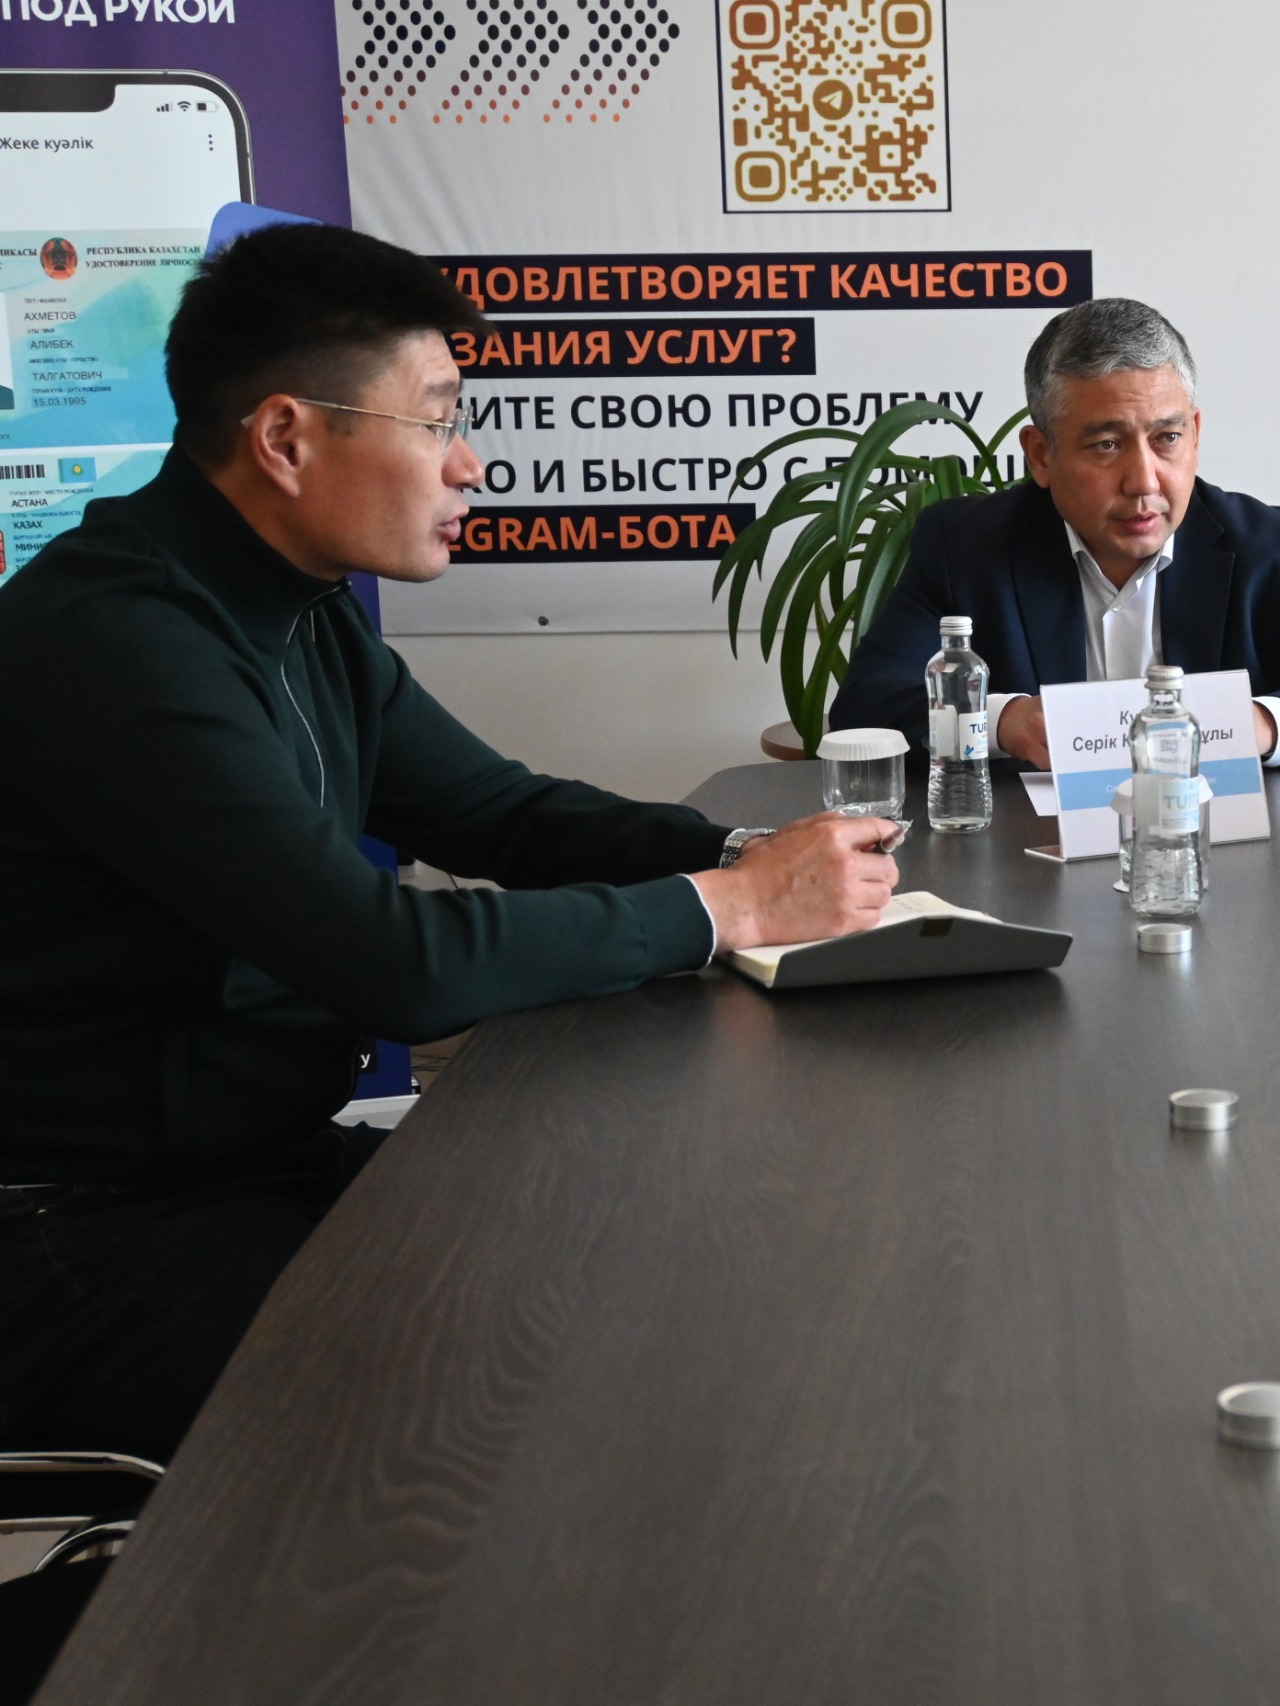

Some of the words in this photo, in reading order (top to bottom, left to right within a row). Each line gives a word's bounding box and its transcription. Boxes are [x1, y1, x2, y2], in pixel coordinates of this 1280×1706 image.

[2, 0, 98, 27] ПОД
[44, 136, 94, 153] куәлік
[86, 246, 147, 255] РЕСПУБЛИКА
[159, 258, 202, 267] ЛИЧНОСТ
[440, 263, 815, 311] ДОВЛЕТВОРЯЕТ
[831, 261, 1068, 300] КАЧЕСТВО
[24, 311, 77, 321] АХМЕТОВ
[30, 339, 74, 350] АЛИБЕК
[450, 330, 611, 367] ЗАНИЯ
[624, 327, 797, 366] УСЛУГ?
[32, 371, 103, 381] ТАЛГАТОВИЧ
[456, 395, 556, 430] ИТЕ
[570, 393, 712, 430] СВОЮ
[533, 459, 565, 493] И
[582, 456, 767, 492] БЫСТРО
[12, 498, 48, 508] АСТАНА
[13, 520, 43, 530] КАЗАХ
[448, 514, 737, 552] GRAM-БОТА
[1072, 734, 1118, 754] Серік
